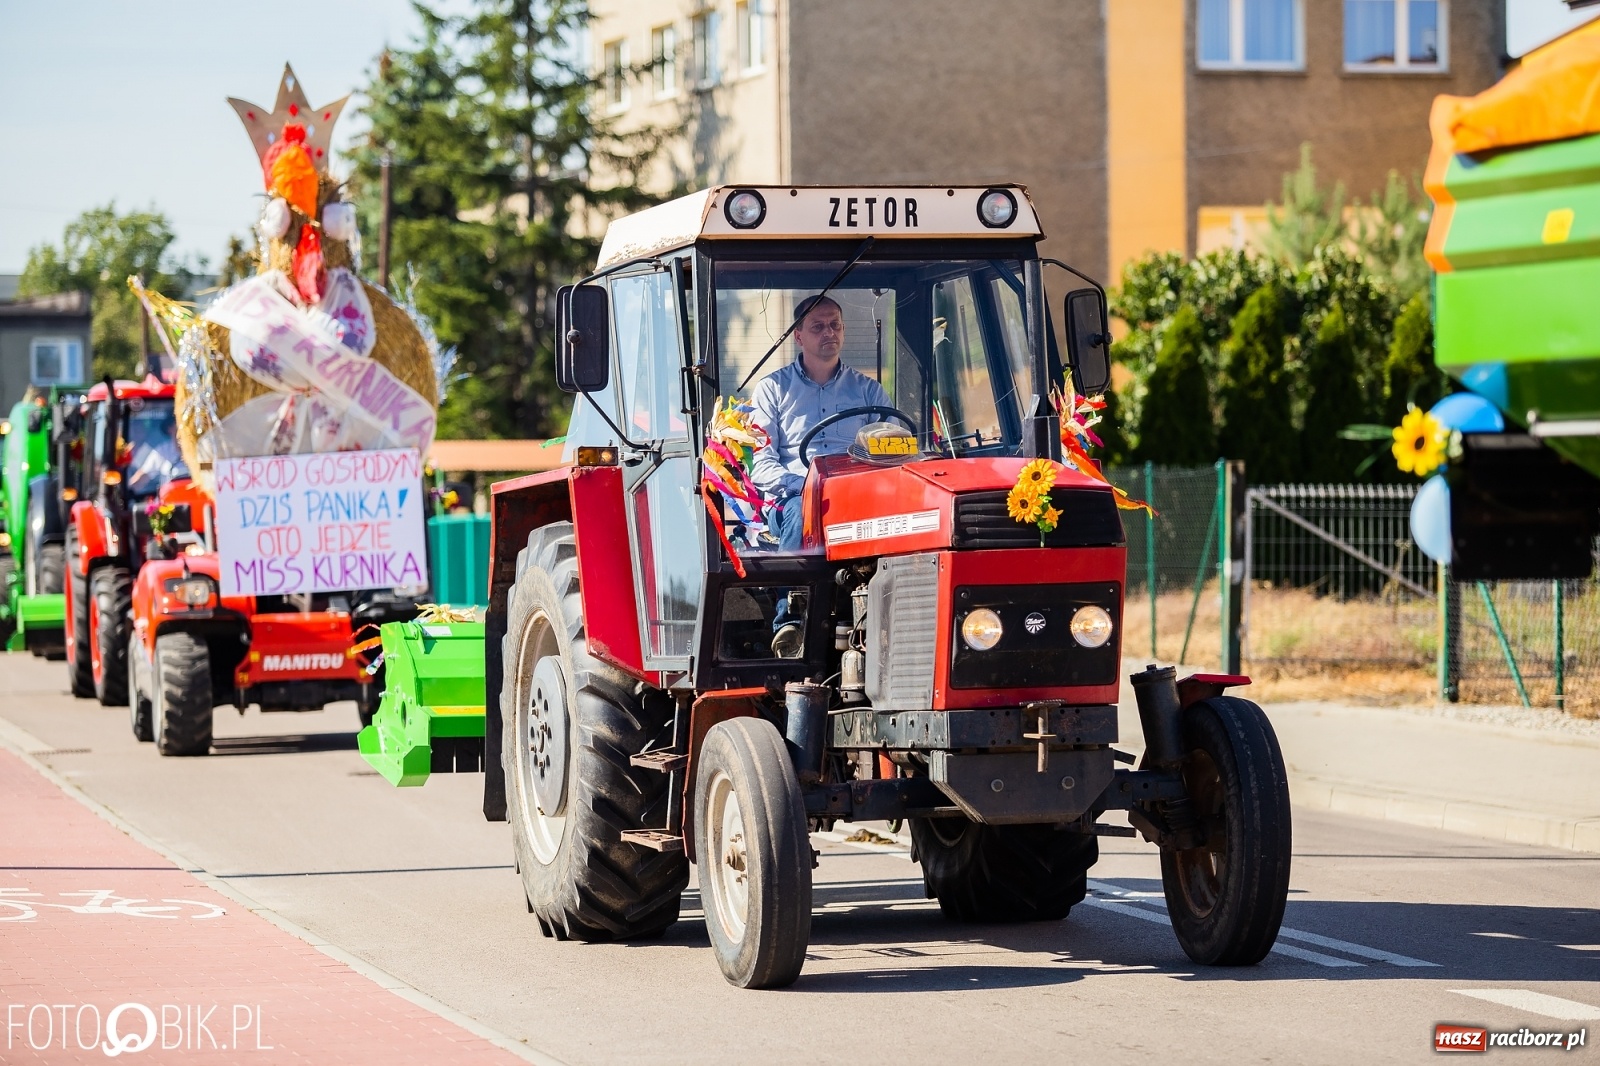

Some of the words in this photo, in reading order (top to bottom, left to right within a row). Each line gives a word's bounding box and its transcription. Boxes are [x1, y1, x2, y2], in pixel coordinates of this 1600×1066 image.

[829, 197, 918, 227] ZETOR
[293, 334, 434, 449] KURNIKA
[257, 525, 301, 558] OTO
[311, 521, 391, 554] JEDZIE
[235, 557, 304, 593] MISS
[313, 552, 421, 588] KURNIKA
[264, 653, 344, 671] MANITOU
